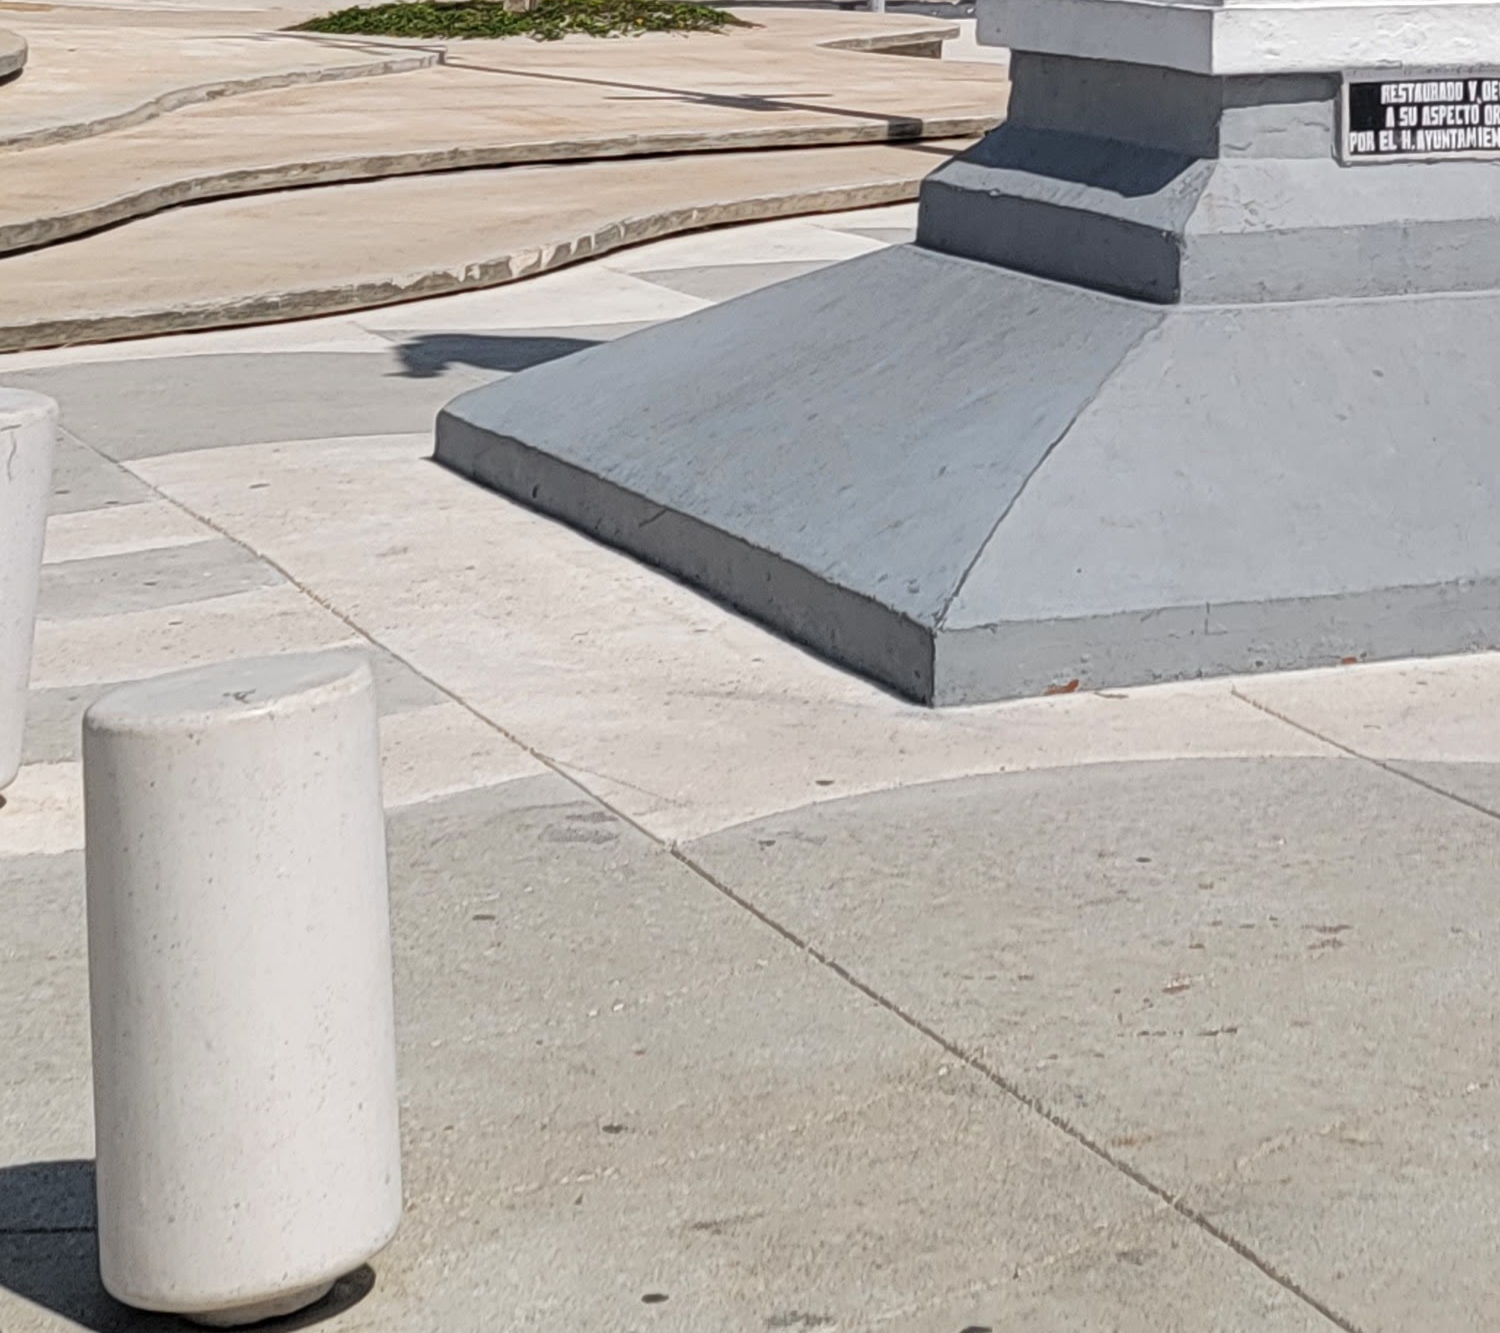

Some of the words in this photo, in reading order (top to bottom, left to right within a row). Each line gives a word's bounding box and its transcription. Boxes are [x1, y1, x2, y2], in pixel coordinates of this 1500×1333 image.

[1381, 82, 1463, 104] RESTAURADO
[1386, 107, 1395, 128] A
[1399, 107, 1417, 127] SU
[1422, 104, 1479, 126] ASPECTO
[1350, 130, 1375, 152] POR
[1379, 130, 1397, 151] EL
